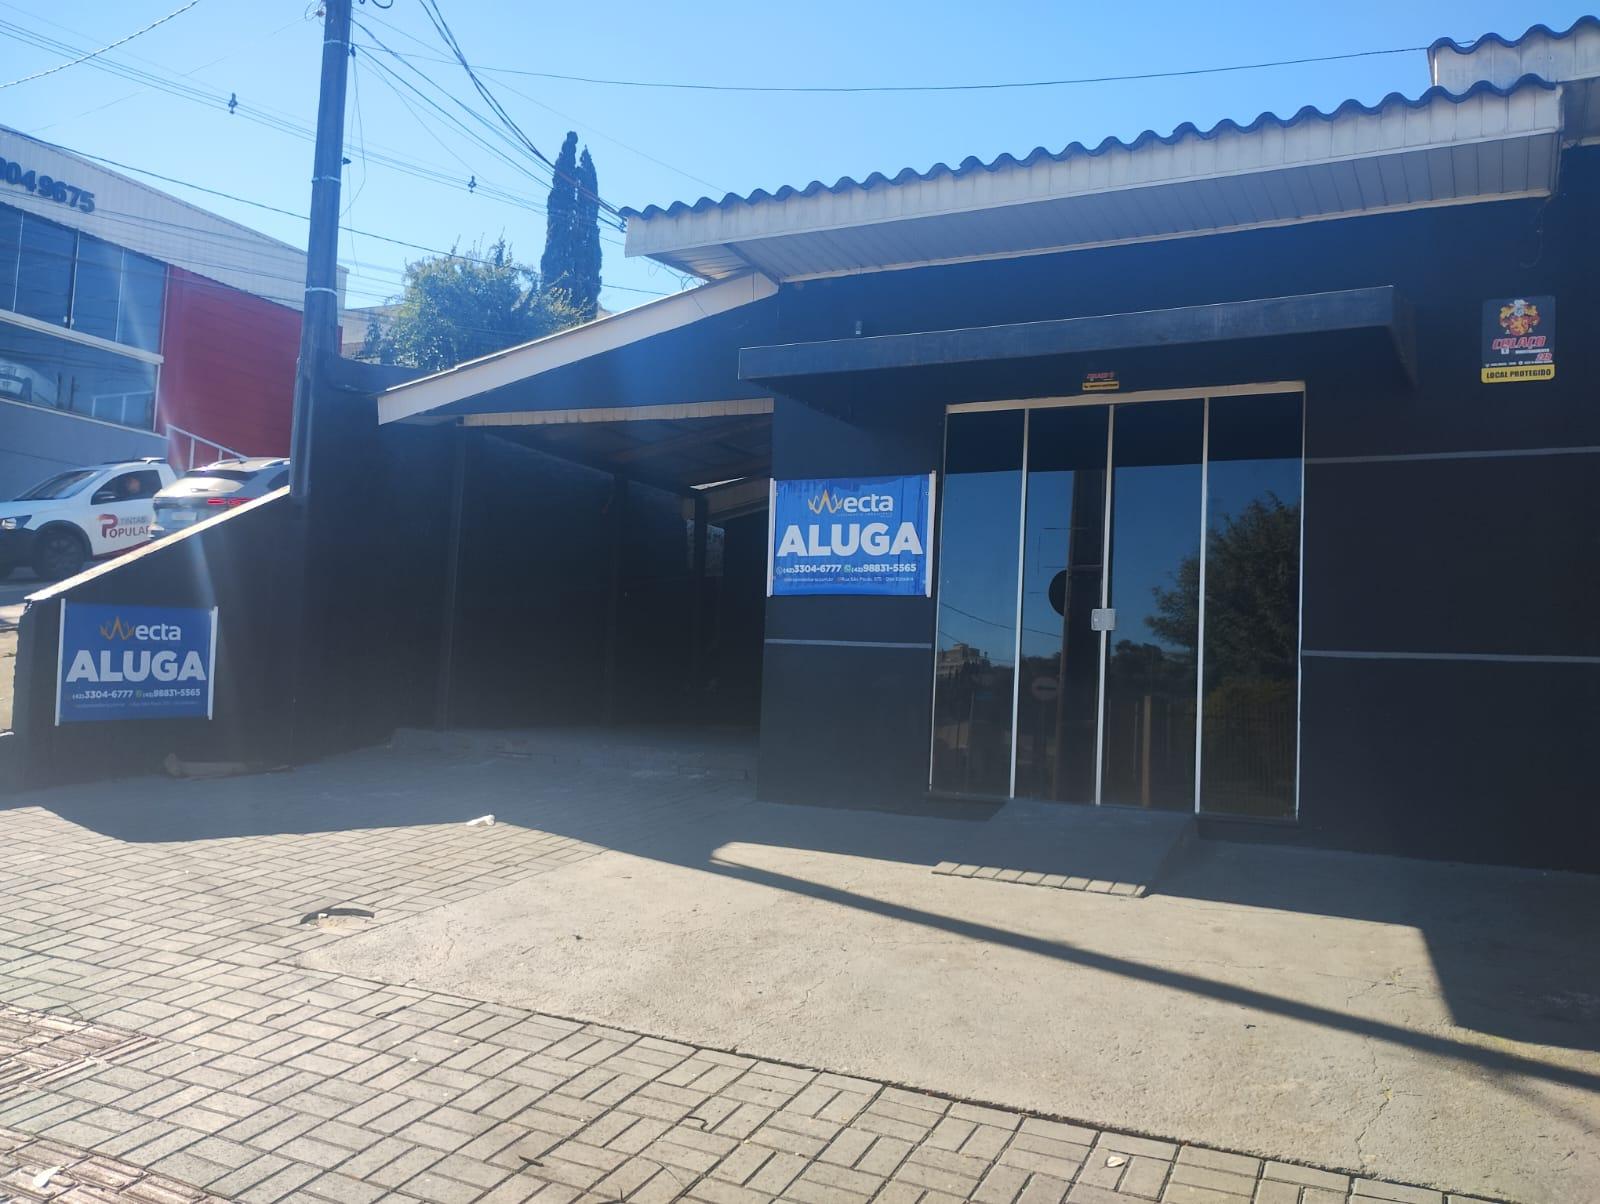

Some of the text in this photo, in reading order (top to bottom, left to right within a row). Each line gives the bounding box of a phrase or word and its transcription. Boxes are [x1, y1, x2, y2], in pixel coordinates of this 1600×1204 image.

[1486, 369, 1551, 379] LOCAL PROTEGIDO
[777, 522, 924, 557] ALUGA
[65, 650, 207, 682] ALUGA
